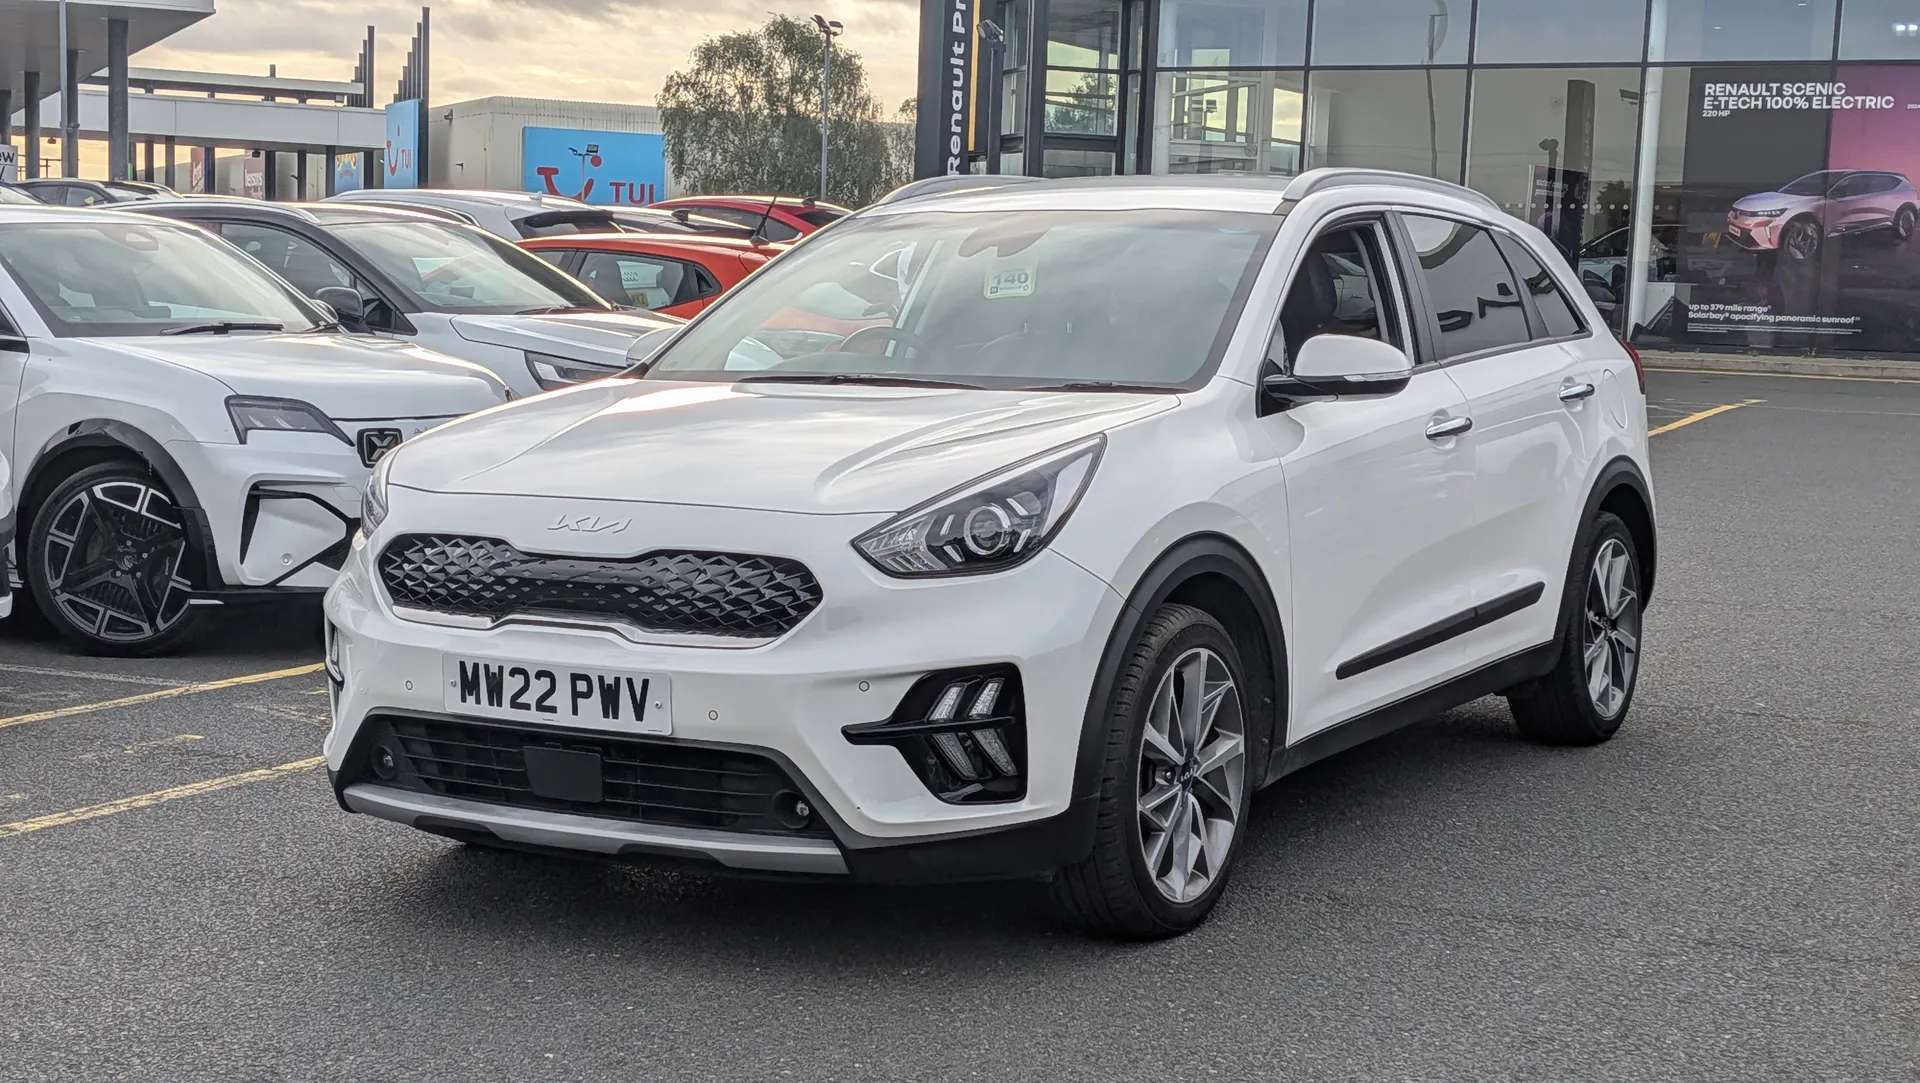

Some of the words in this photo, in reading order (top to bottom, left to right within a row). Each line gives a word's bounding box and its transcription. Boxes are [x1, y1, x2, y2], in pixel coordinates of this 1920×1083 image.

[1704, 82, 1781, 96] RENAULT
[1782, 82, 1847, 96] SCENIC
[947, 41, 965, 176] Renault
[1703, 96, 1763, 110] E-TECH
[1765, 96, 1809, 110] 100%
[1812, 95, 1896, 109] ELECTRIC
[609, 181, 655, 206] TUI
[992, 271, 1030, 285] 140
[459, 660, 558, 714] MW22
[570, 672, 650, 722] PWV
